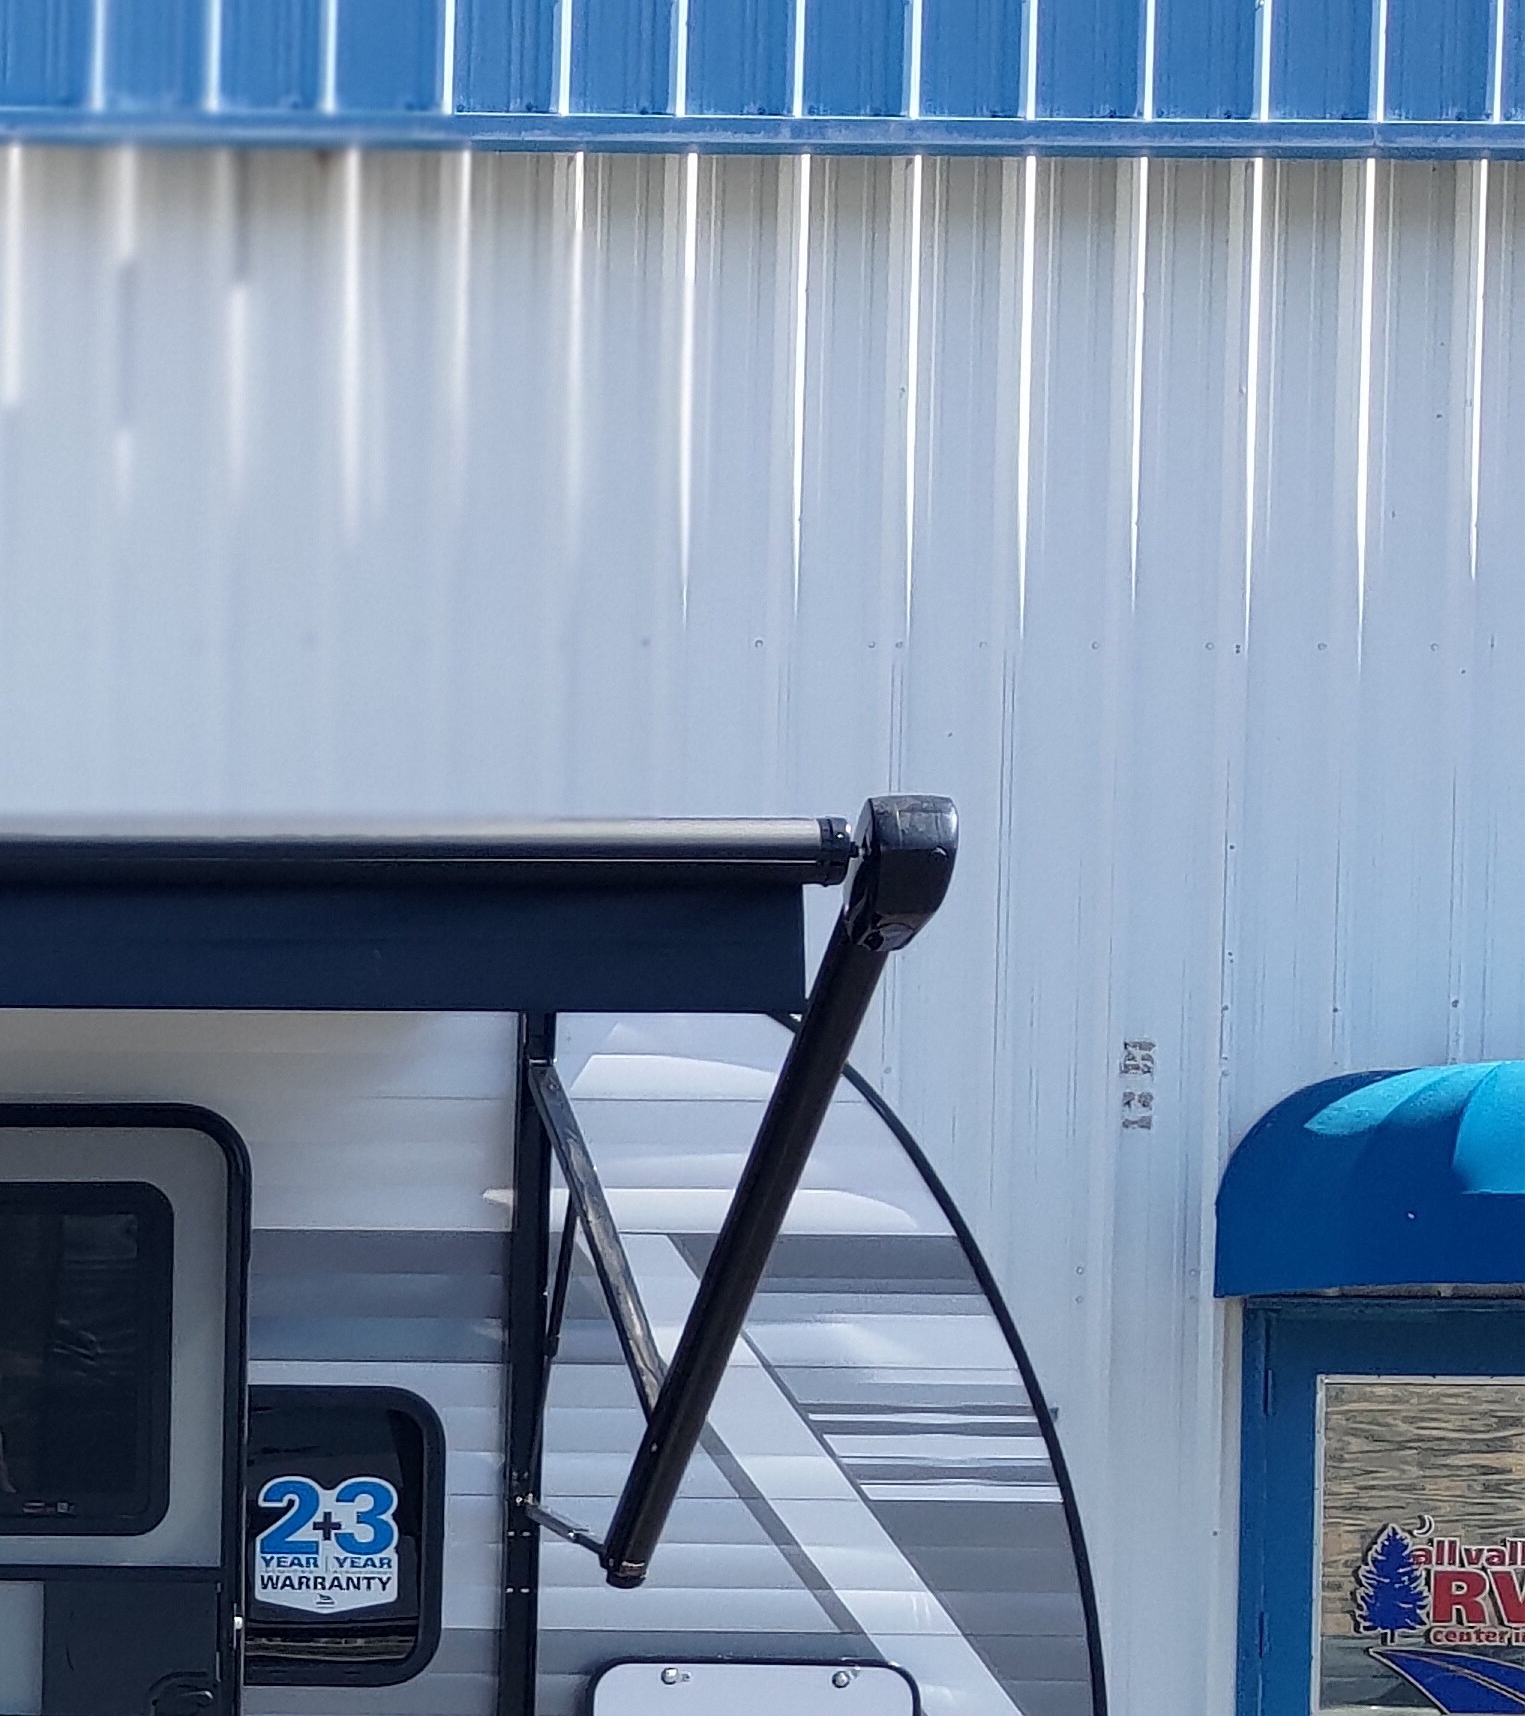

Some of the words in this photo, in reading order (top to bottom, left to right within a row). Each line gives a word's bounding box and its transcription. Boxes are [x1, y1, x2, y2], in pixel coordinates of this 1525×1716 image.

[261, 1556, 319, 1569] YEAR
[334, 1556, 393, 1569] YEAR
[261, 1575, 392, 1591] WARRANTY
[1433, 1628, 1509, 1644] center
